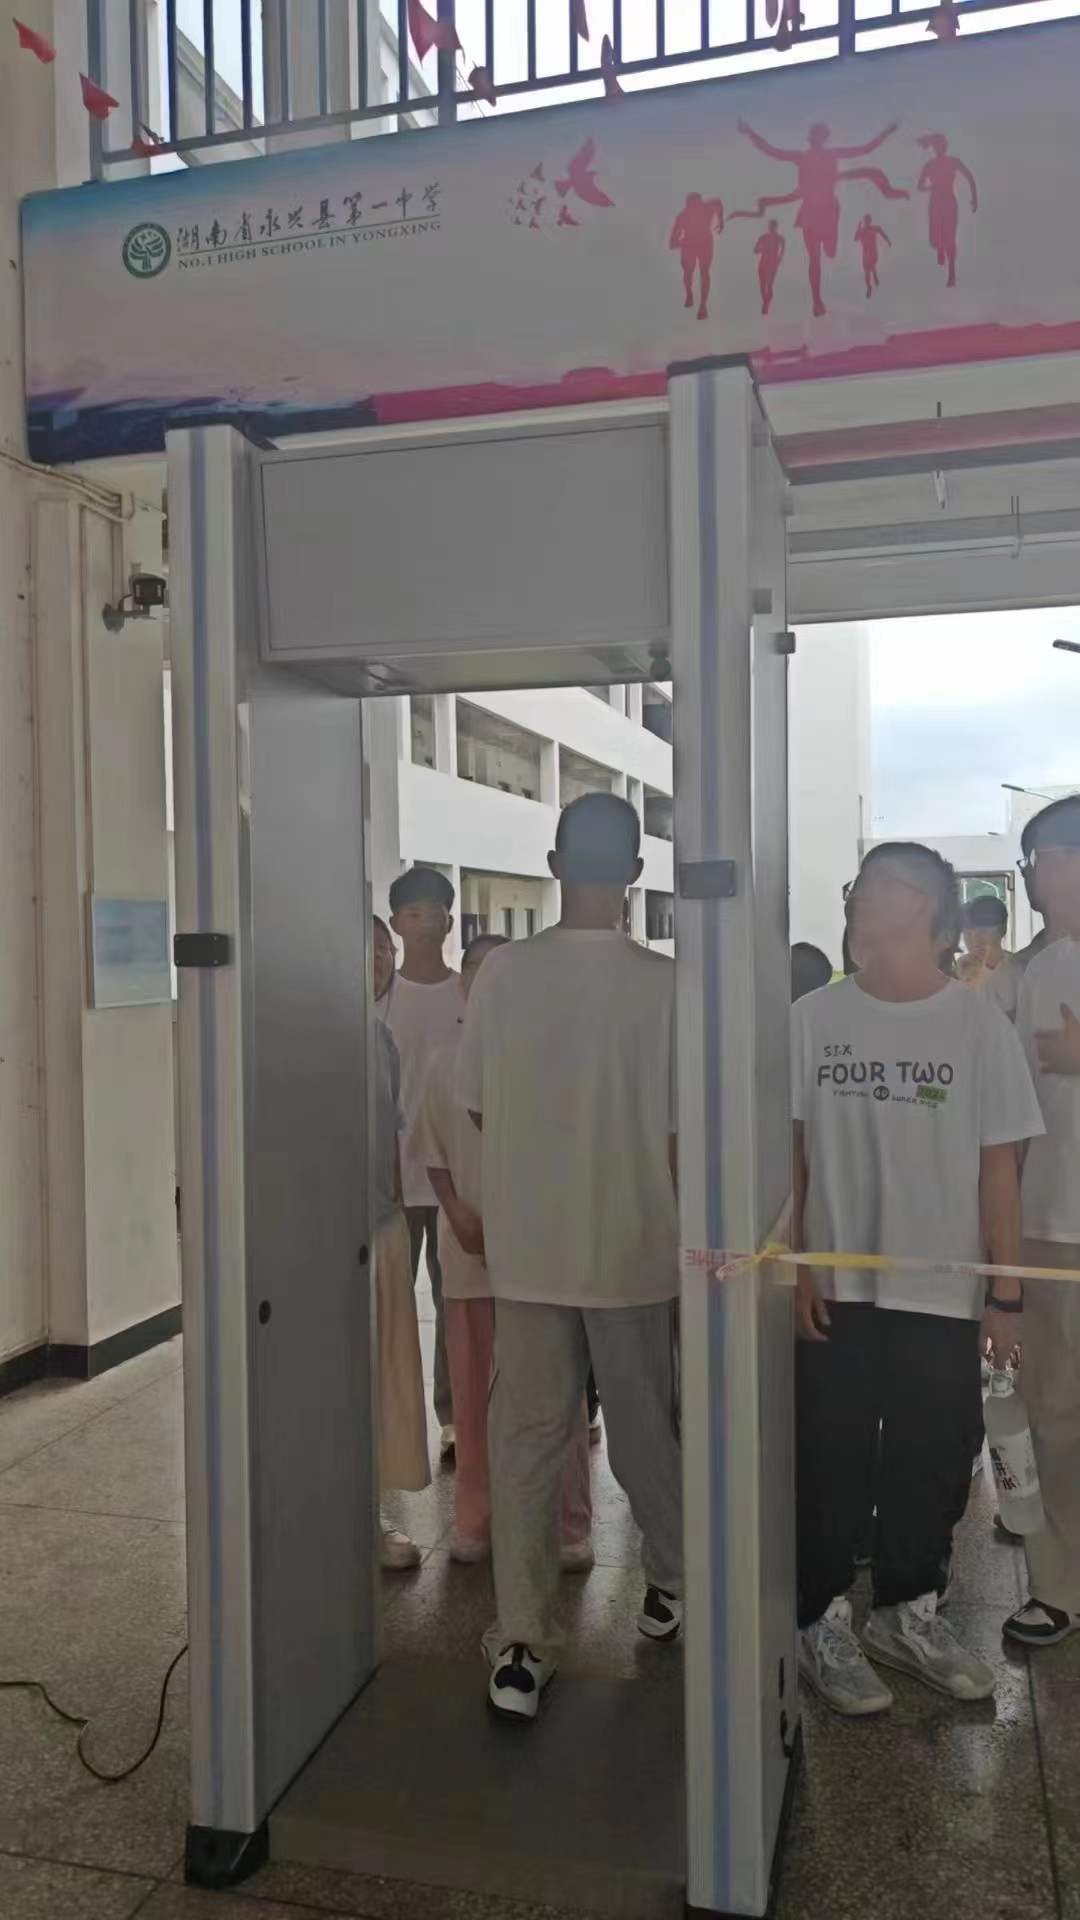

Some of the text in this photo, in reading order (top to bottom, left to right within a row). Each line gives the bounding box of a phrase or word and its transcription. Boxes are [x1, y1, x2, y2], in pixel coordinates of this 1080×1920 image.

[176, 181, 441, 253] 湖南省永兴县第一中学
[217, 248, 257, 265] HIGH
[261, 237, 328, 257] SCHOOL
[329, 235, 346, 249] IN
[352, 221, 441, 243] YONGXING
[824, 1044, 852, 1057] SIX
[817, 1061, 953, 1087] FOUR TWO
